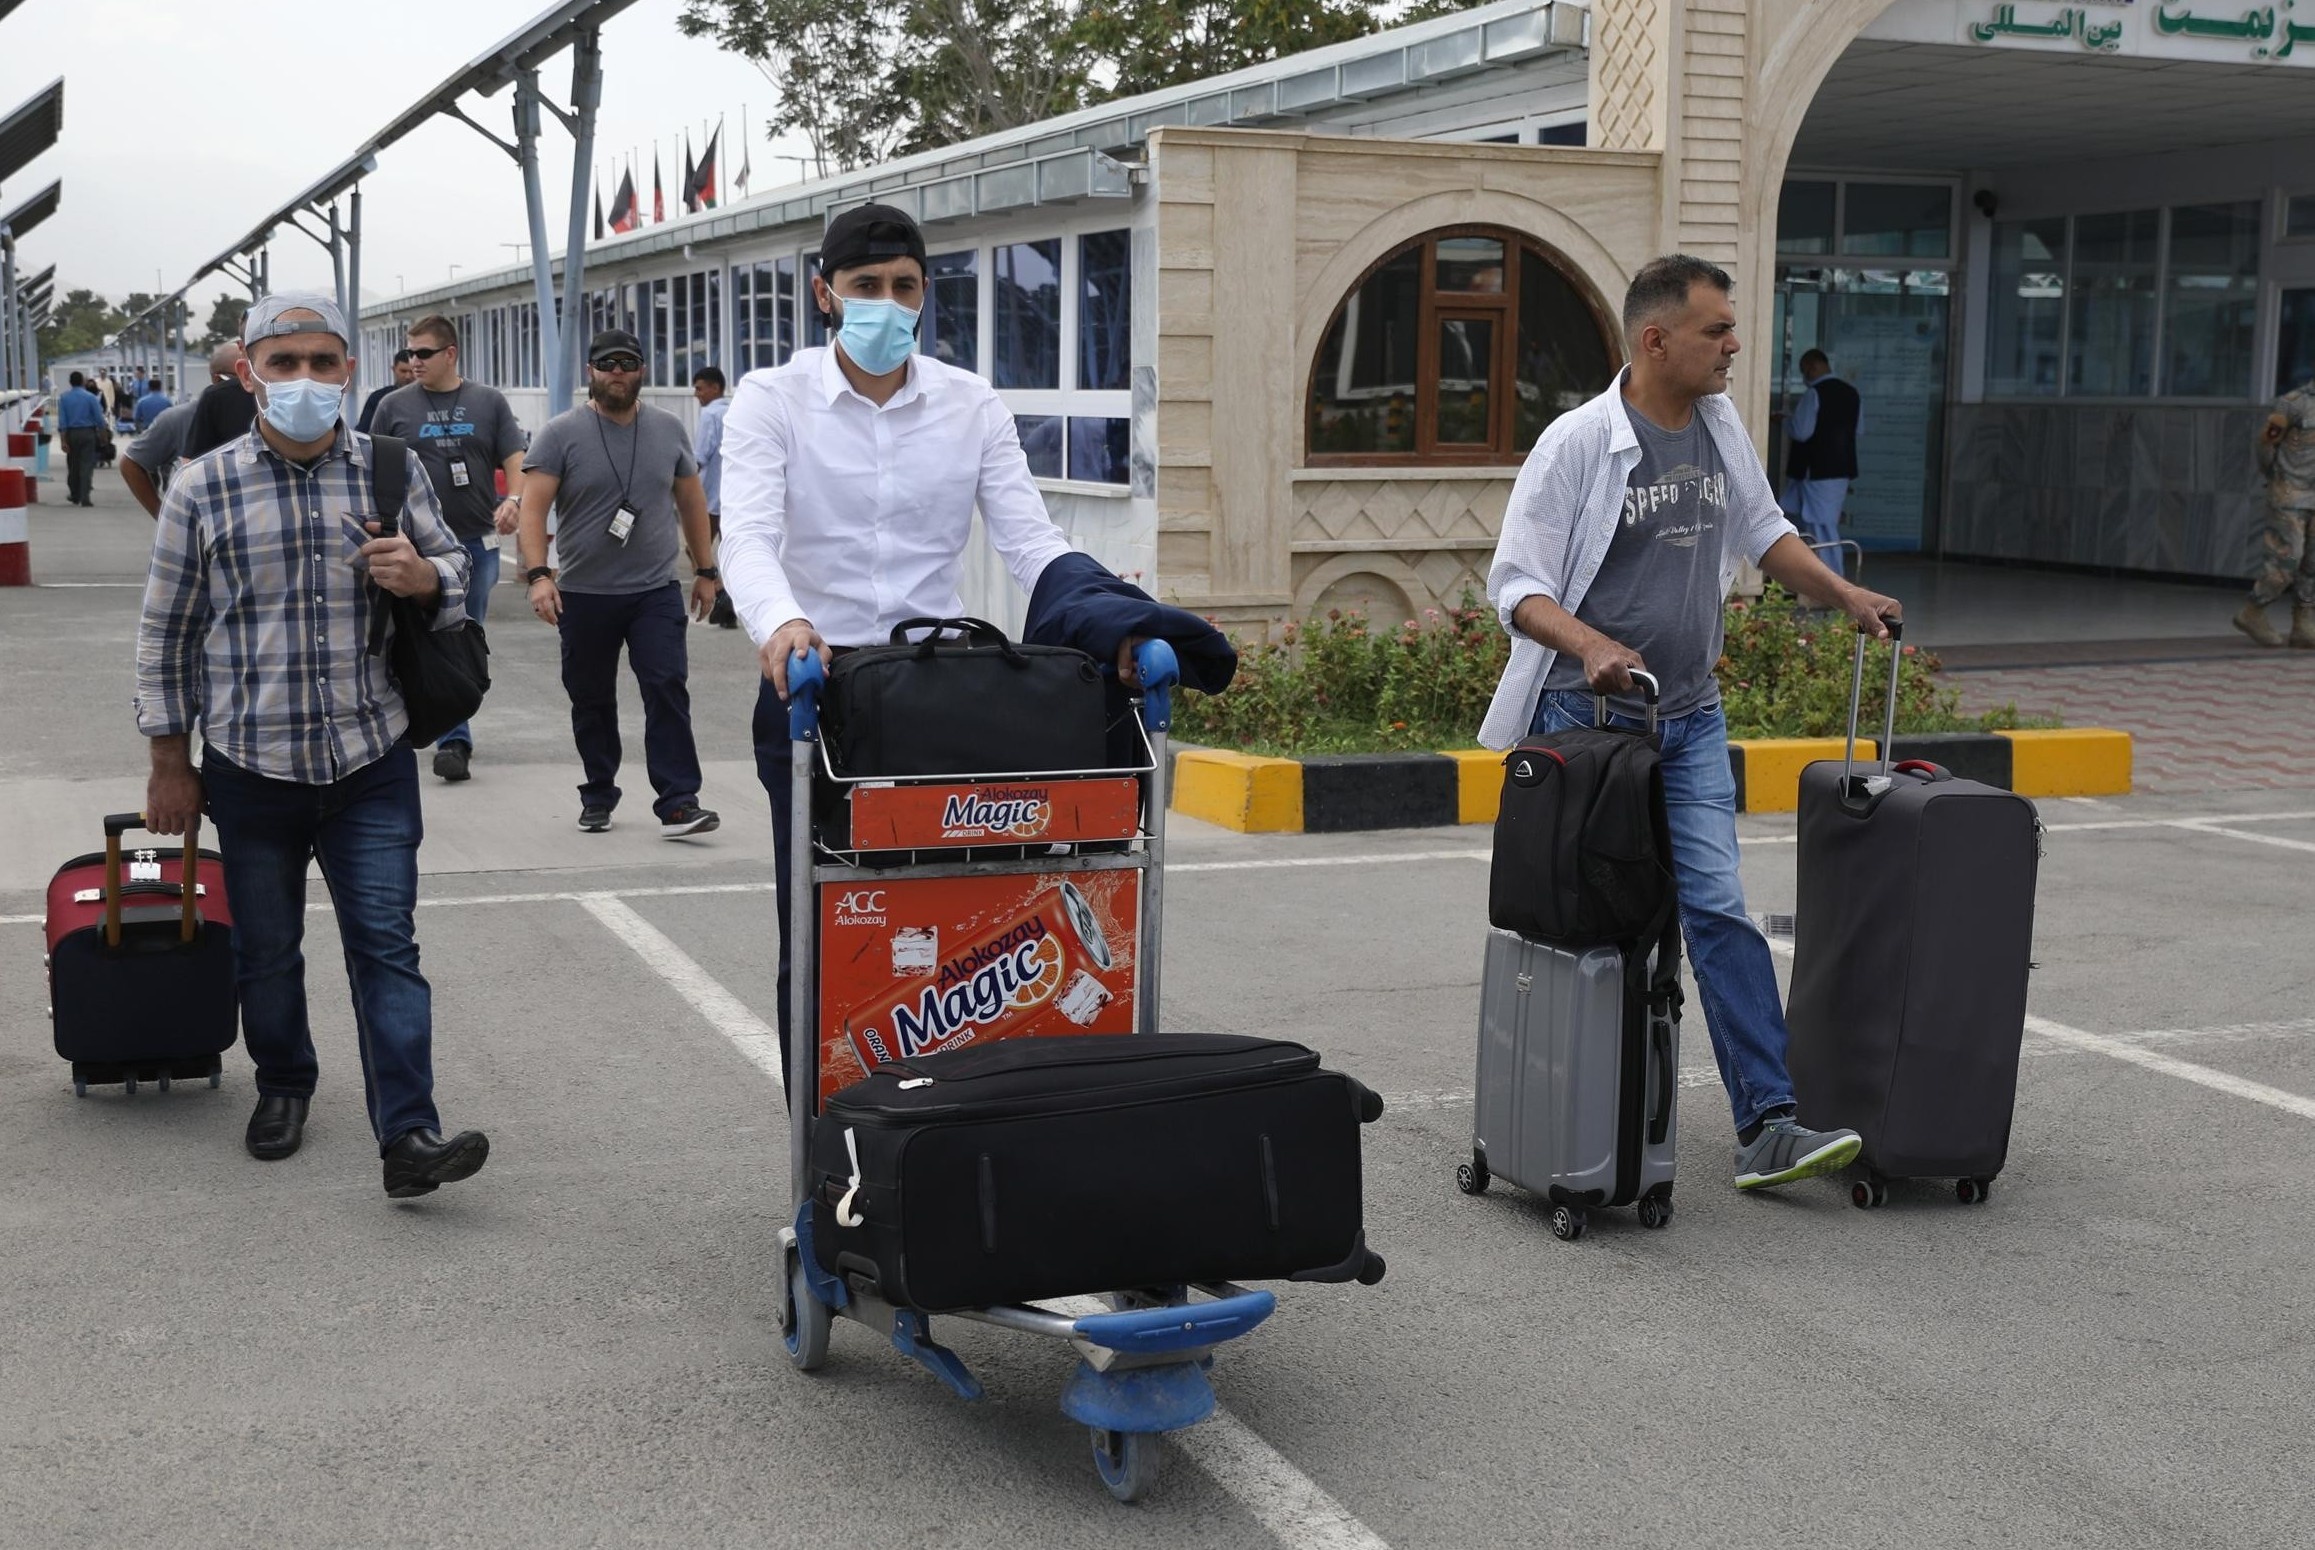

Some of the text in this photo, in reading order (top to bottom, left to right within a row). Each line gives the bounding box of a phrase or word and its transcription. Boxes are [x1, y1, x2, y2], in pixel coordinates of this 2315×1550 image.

[981, 787, 1048, 803] Alokozay
[942, 794, 1041, 833] Magic
[835, 891, 887, 914] AGC
[835, 915, 887, 927] Alokozay
[937, 915, 1046, 989] Alokozay
[892, 940, 1044, 1058] Magic
